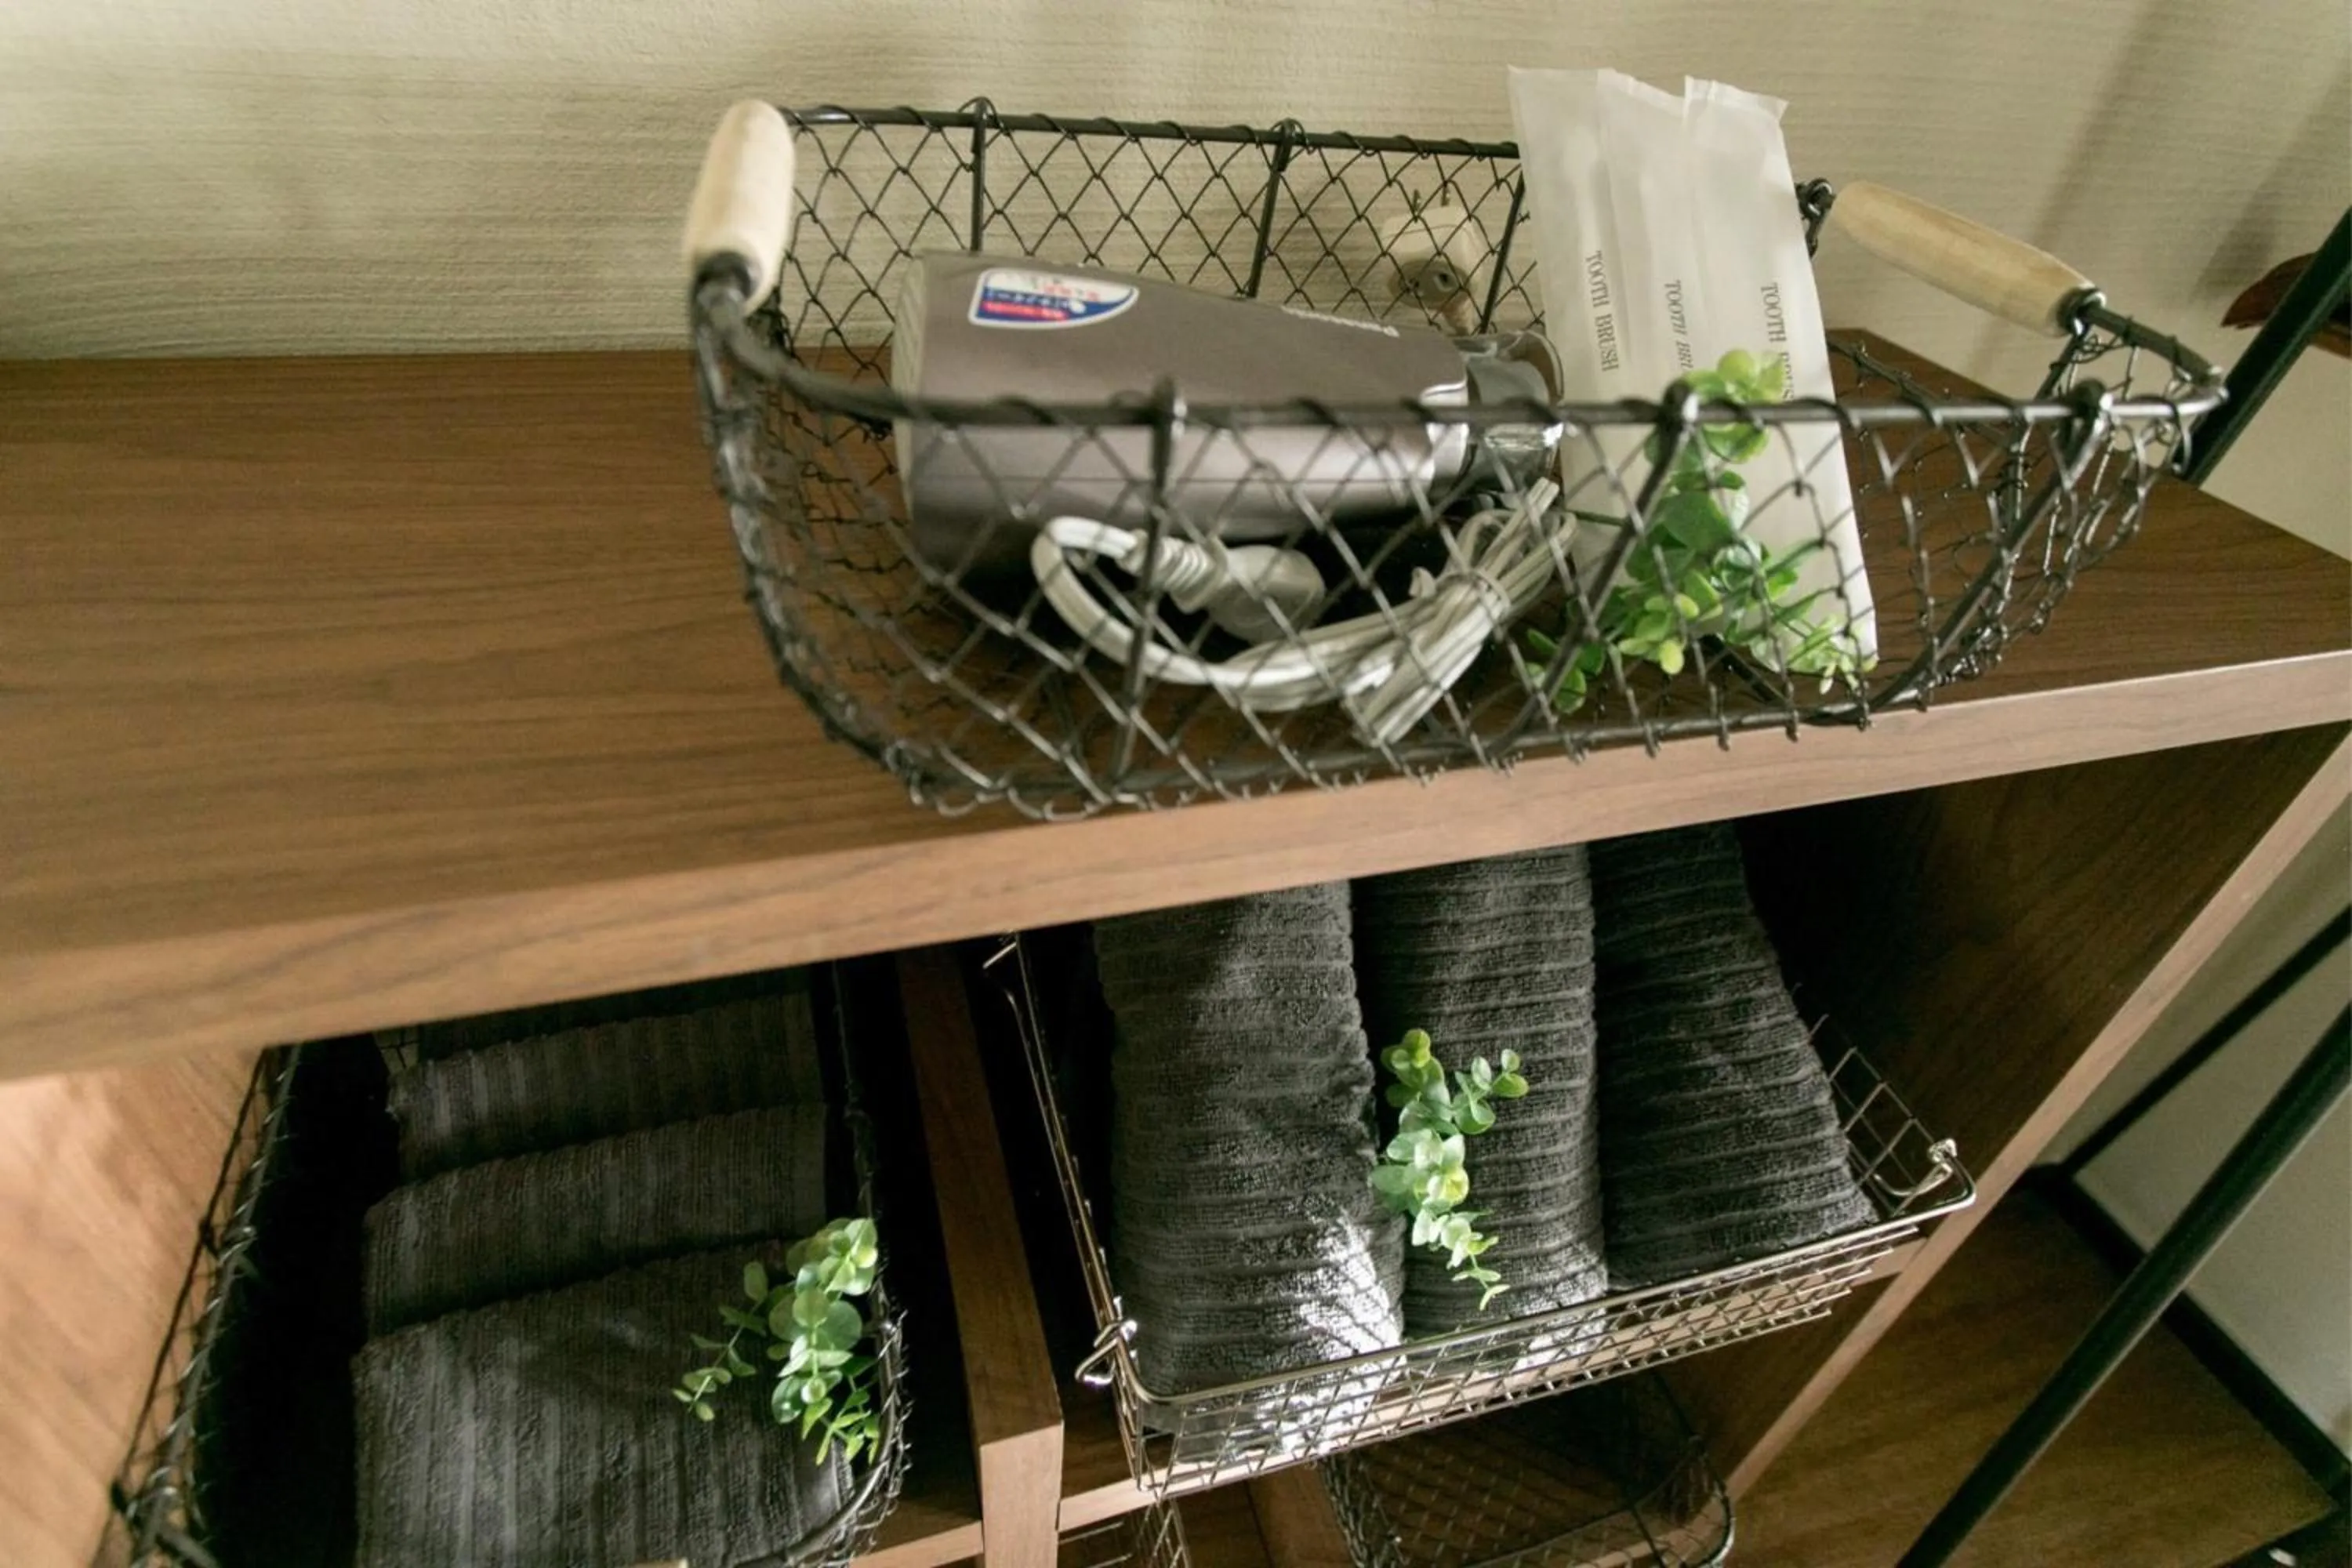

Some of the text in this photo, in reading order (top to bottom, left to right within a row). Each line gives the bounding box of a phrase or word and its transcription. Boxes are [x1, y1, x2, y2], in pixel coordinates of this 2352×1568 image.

[1585, 250, 1619, 372] TOOTH BRUSH
[1664, 280, 1687, 335] TOOTH
[1761, 282, 1787, 342] TOOTH
